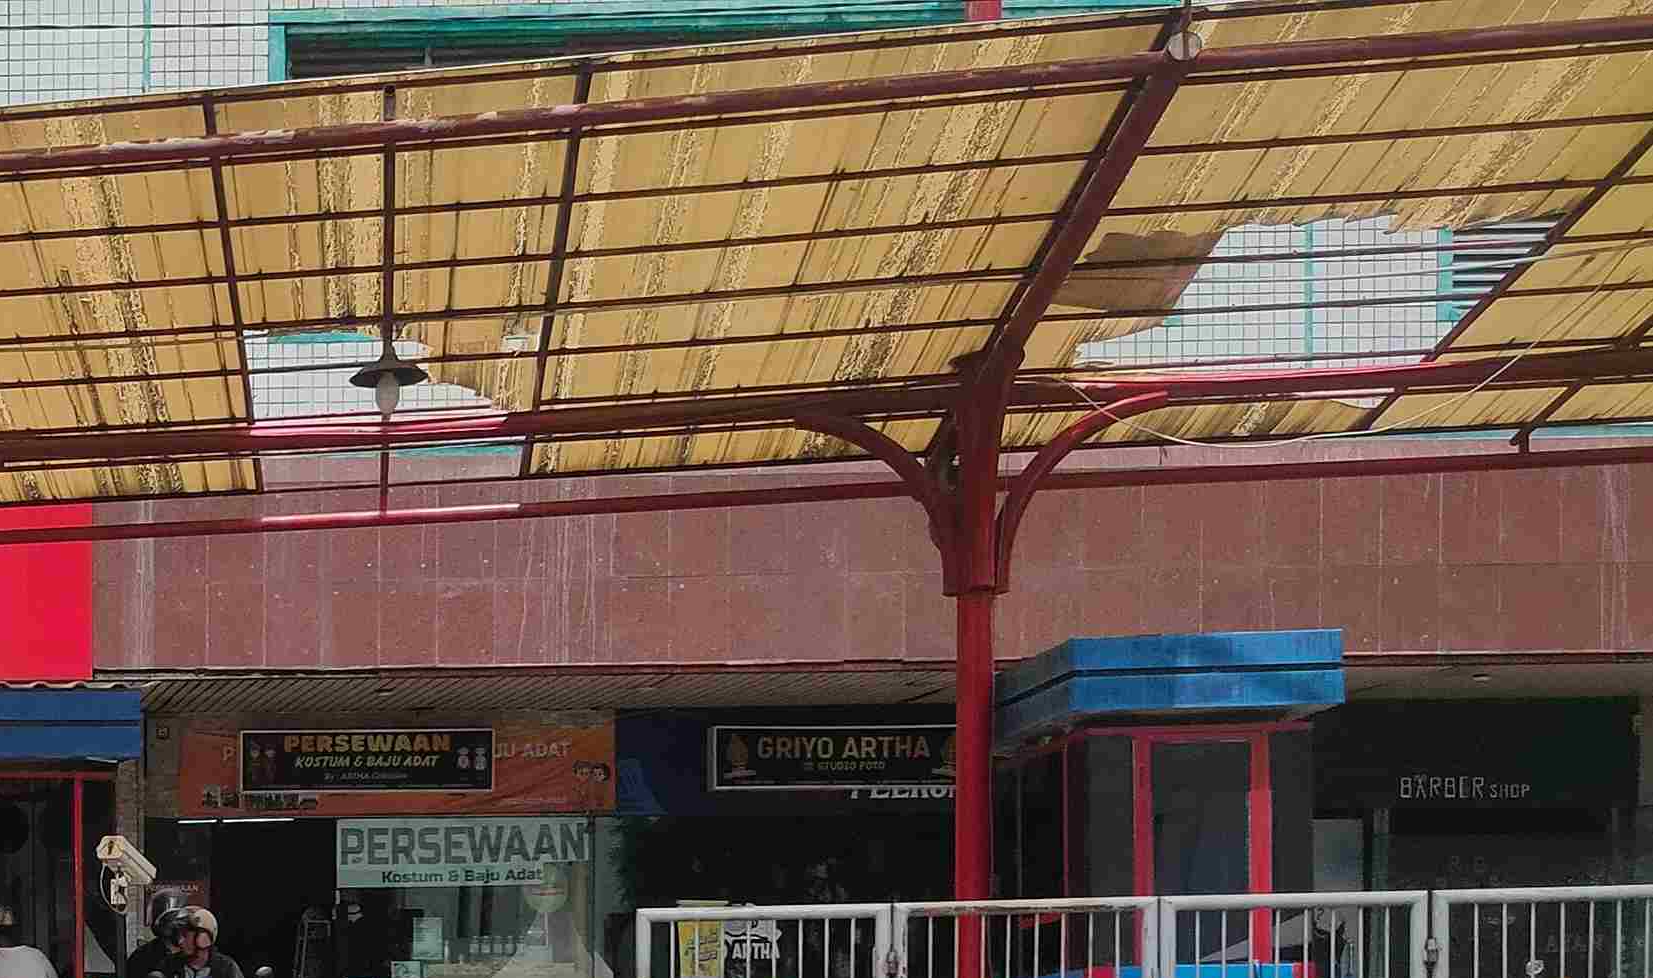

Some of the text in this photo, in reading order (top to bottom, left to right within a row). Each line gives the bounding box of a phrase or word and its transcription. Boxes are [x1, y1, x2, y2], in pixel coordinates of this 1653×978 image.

[284, 734, 452, 752] PERSEWAAN
[757, 735, 931, 760] GRIYO ARTHA
[294, 755, 441, 768] KOSTUM & BAJU ADAT
[1400, 775, 1531, 799] BARBER SHOP
[340, 823, 587, 866] PERSEWAAN
[381, 868, 543, 885] Kostum & Baju Adat
